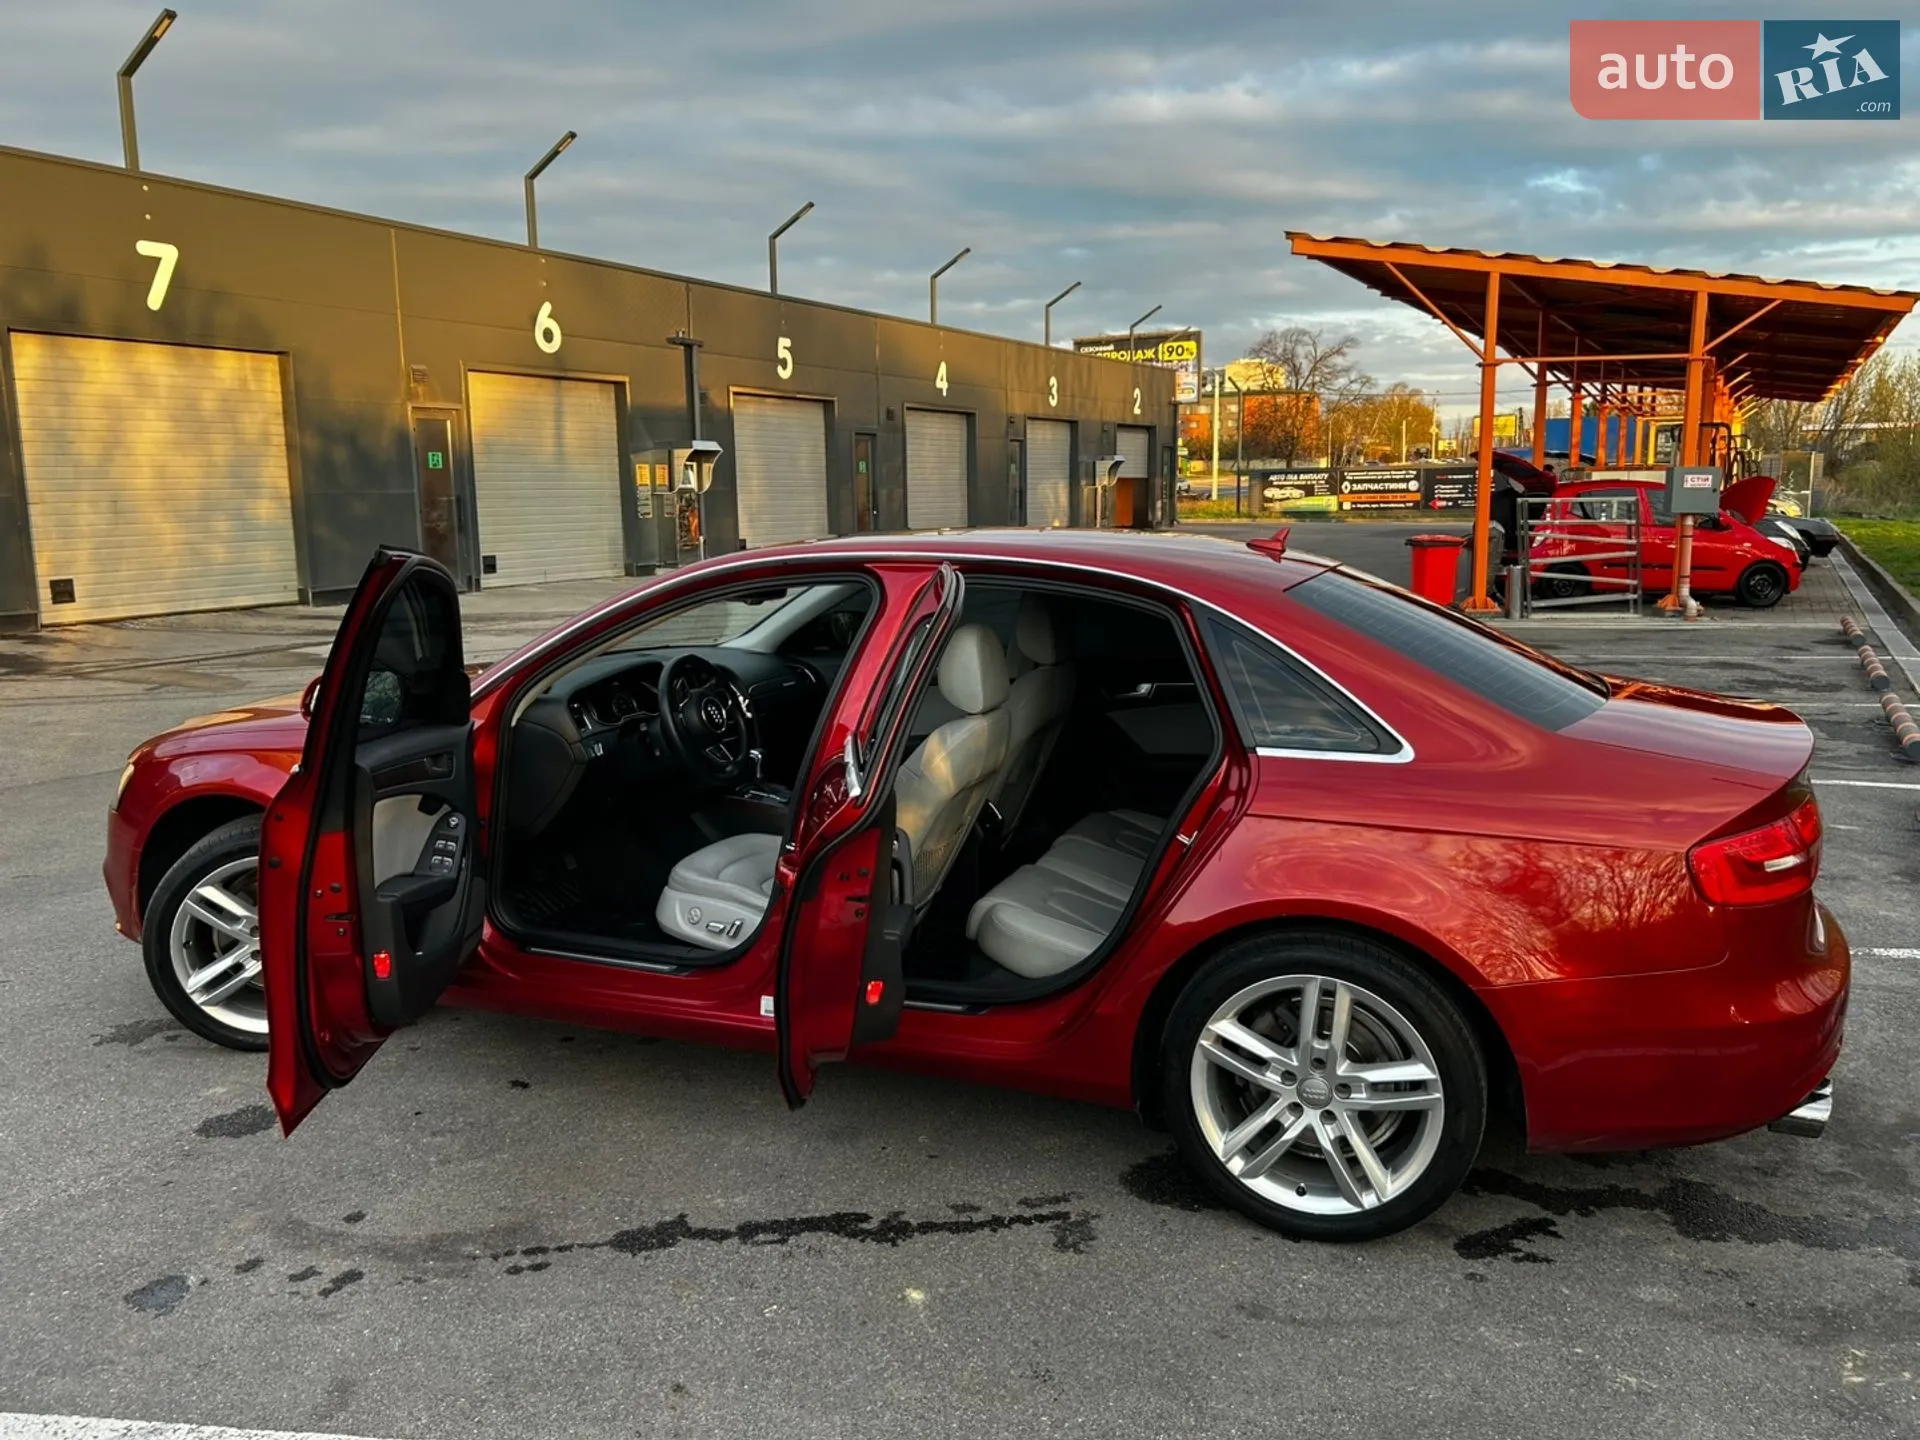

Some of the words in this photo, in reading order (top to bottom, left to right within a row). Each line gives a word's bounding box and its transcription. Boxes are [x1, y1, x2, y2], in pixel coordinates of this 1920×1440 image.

[135, 240, 179, 311] 7
[534, 301, 562, 354] 6
[777, 336, 794, 380] 5
[935, 361, 949, 397] 4
[1049, 376, 1058, 407] 3
[1133, 387, 1142, 415] 2
[1351, 482, 1408, 491] ЗАПЧАСТИНИ
